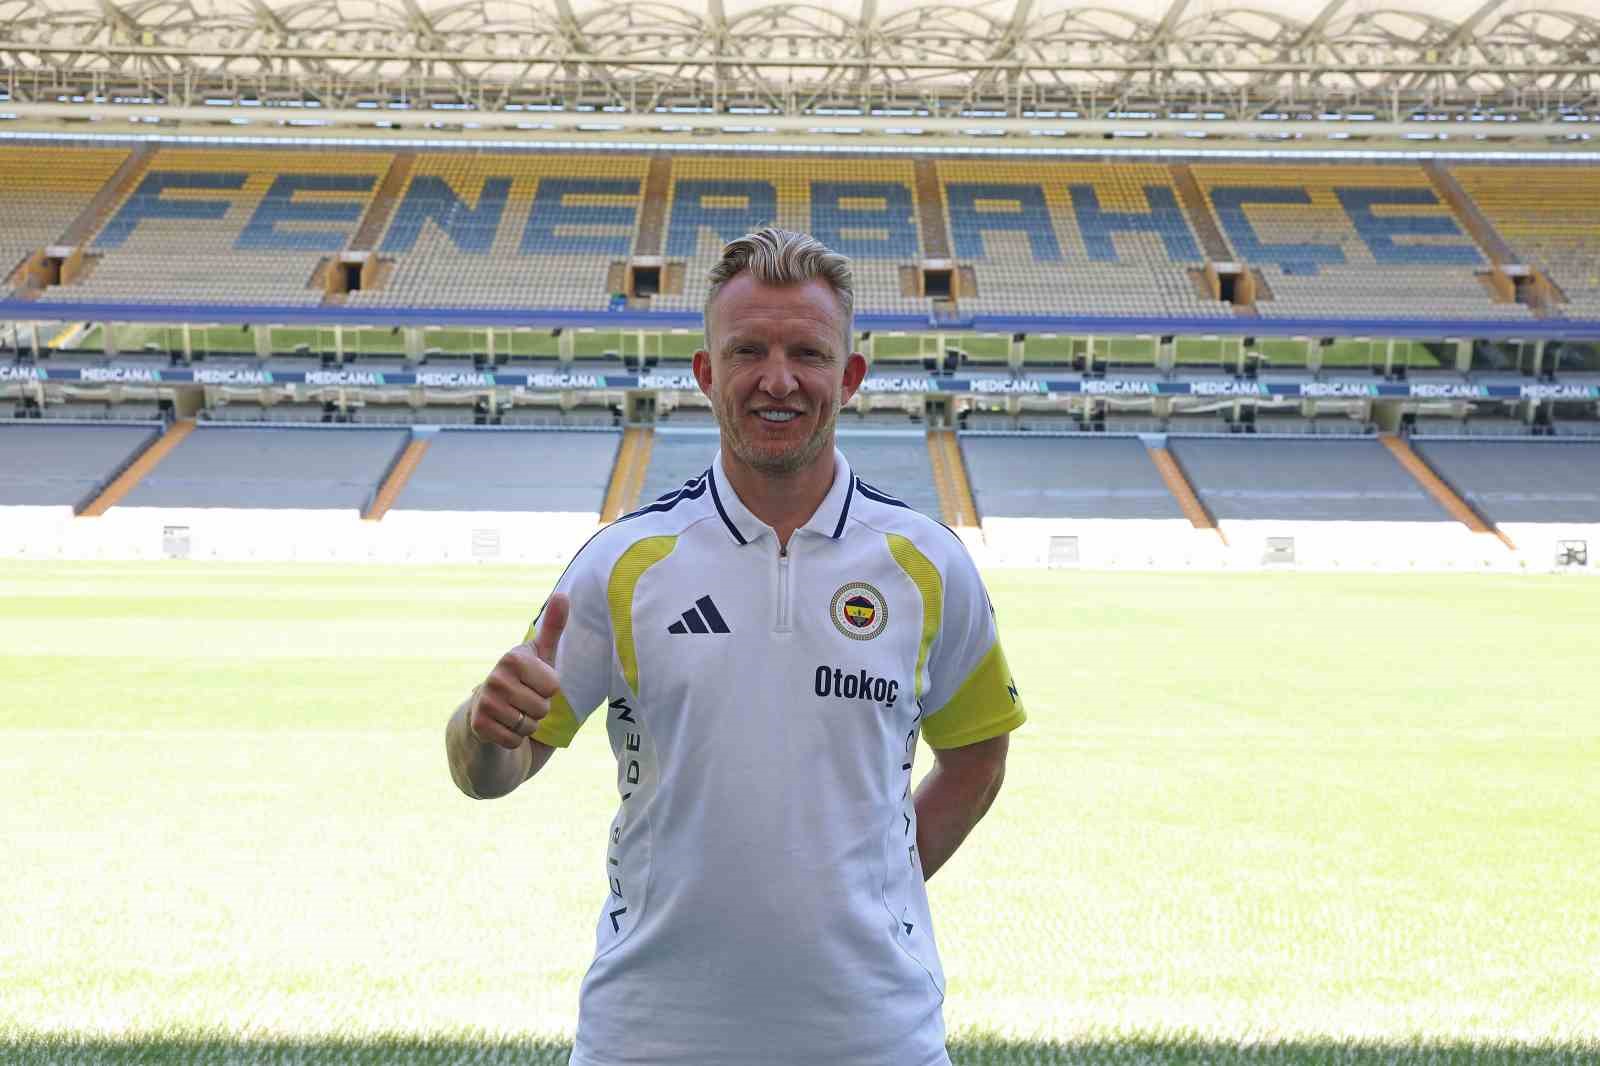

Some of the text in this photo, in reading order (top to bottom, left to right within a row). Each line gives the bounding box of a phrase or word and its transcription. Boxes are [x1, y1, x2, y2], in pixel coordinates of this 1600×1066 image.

[92, 169, 1488, 277] FENERBAHÇE
[80, 368, 153, 381] MEDICANA
[193, 370, 265, 383] MEDICANA
[305, 371, 376, 384] MEDICANA
[416, 372, 486, 385] MEDICANA
[527, 373, 598, 386] MEDICANA
[638, 375, 698, 389] MEDICAN
[860, 378, 929, 392] MEDICANA
[970, 379, 1040, 392] MEDICANA
[1080, 380, 1151, 394] MEDICANA
[1190, 381, 1261, 395] MEDICANA
[1300, 383, 1370, 396] MEDICANA
[1409, 384, 1480, 397] MEDICANA
[1520, 384, 1589, 398] MEDICANA
[814, 665, 899, 707] Otokoç
